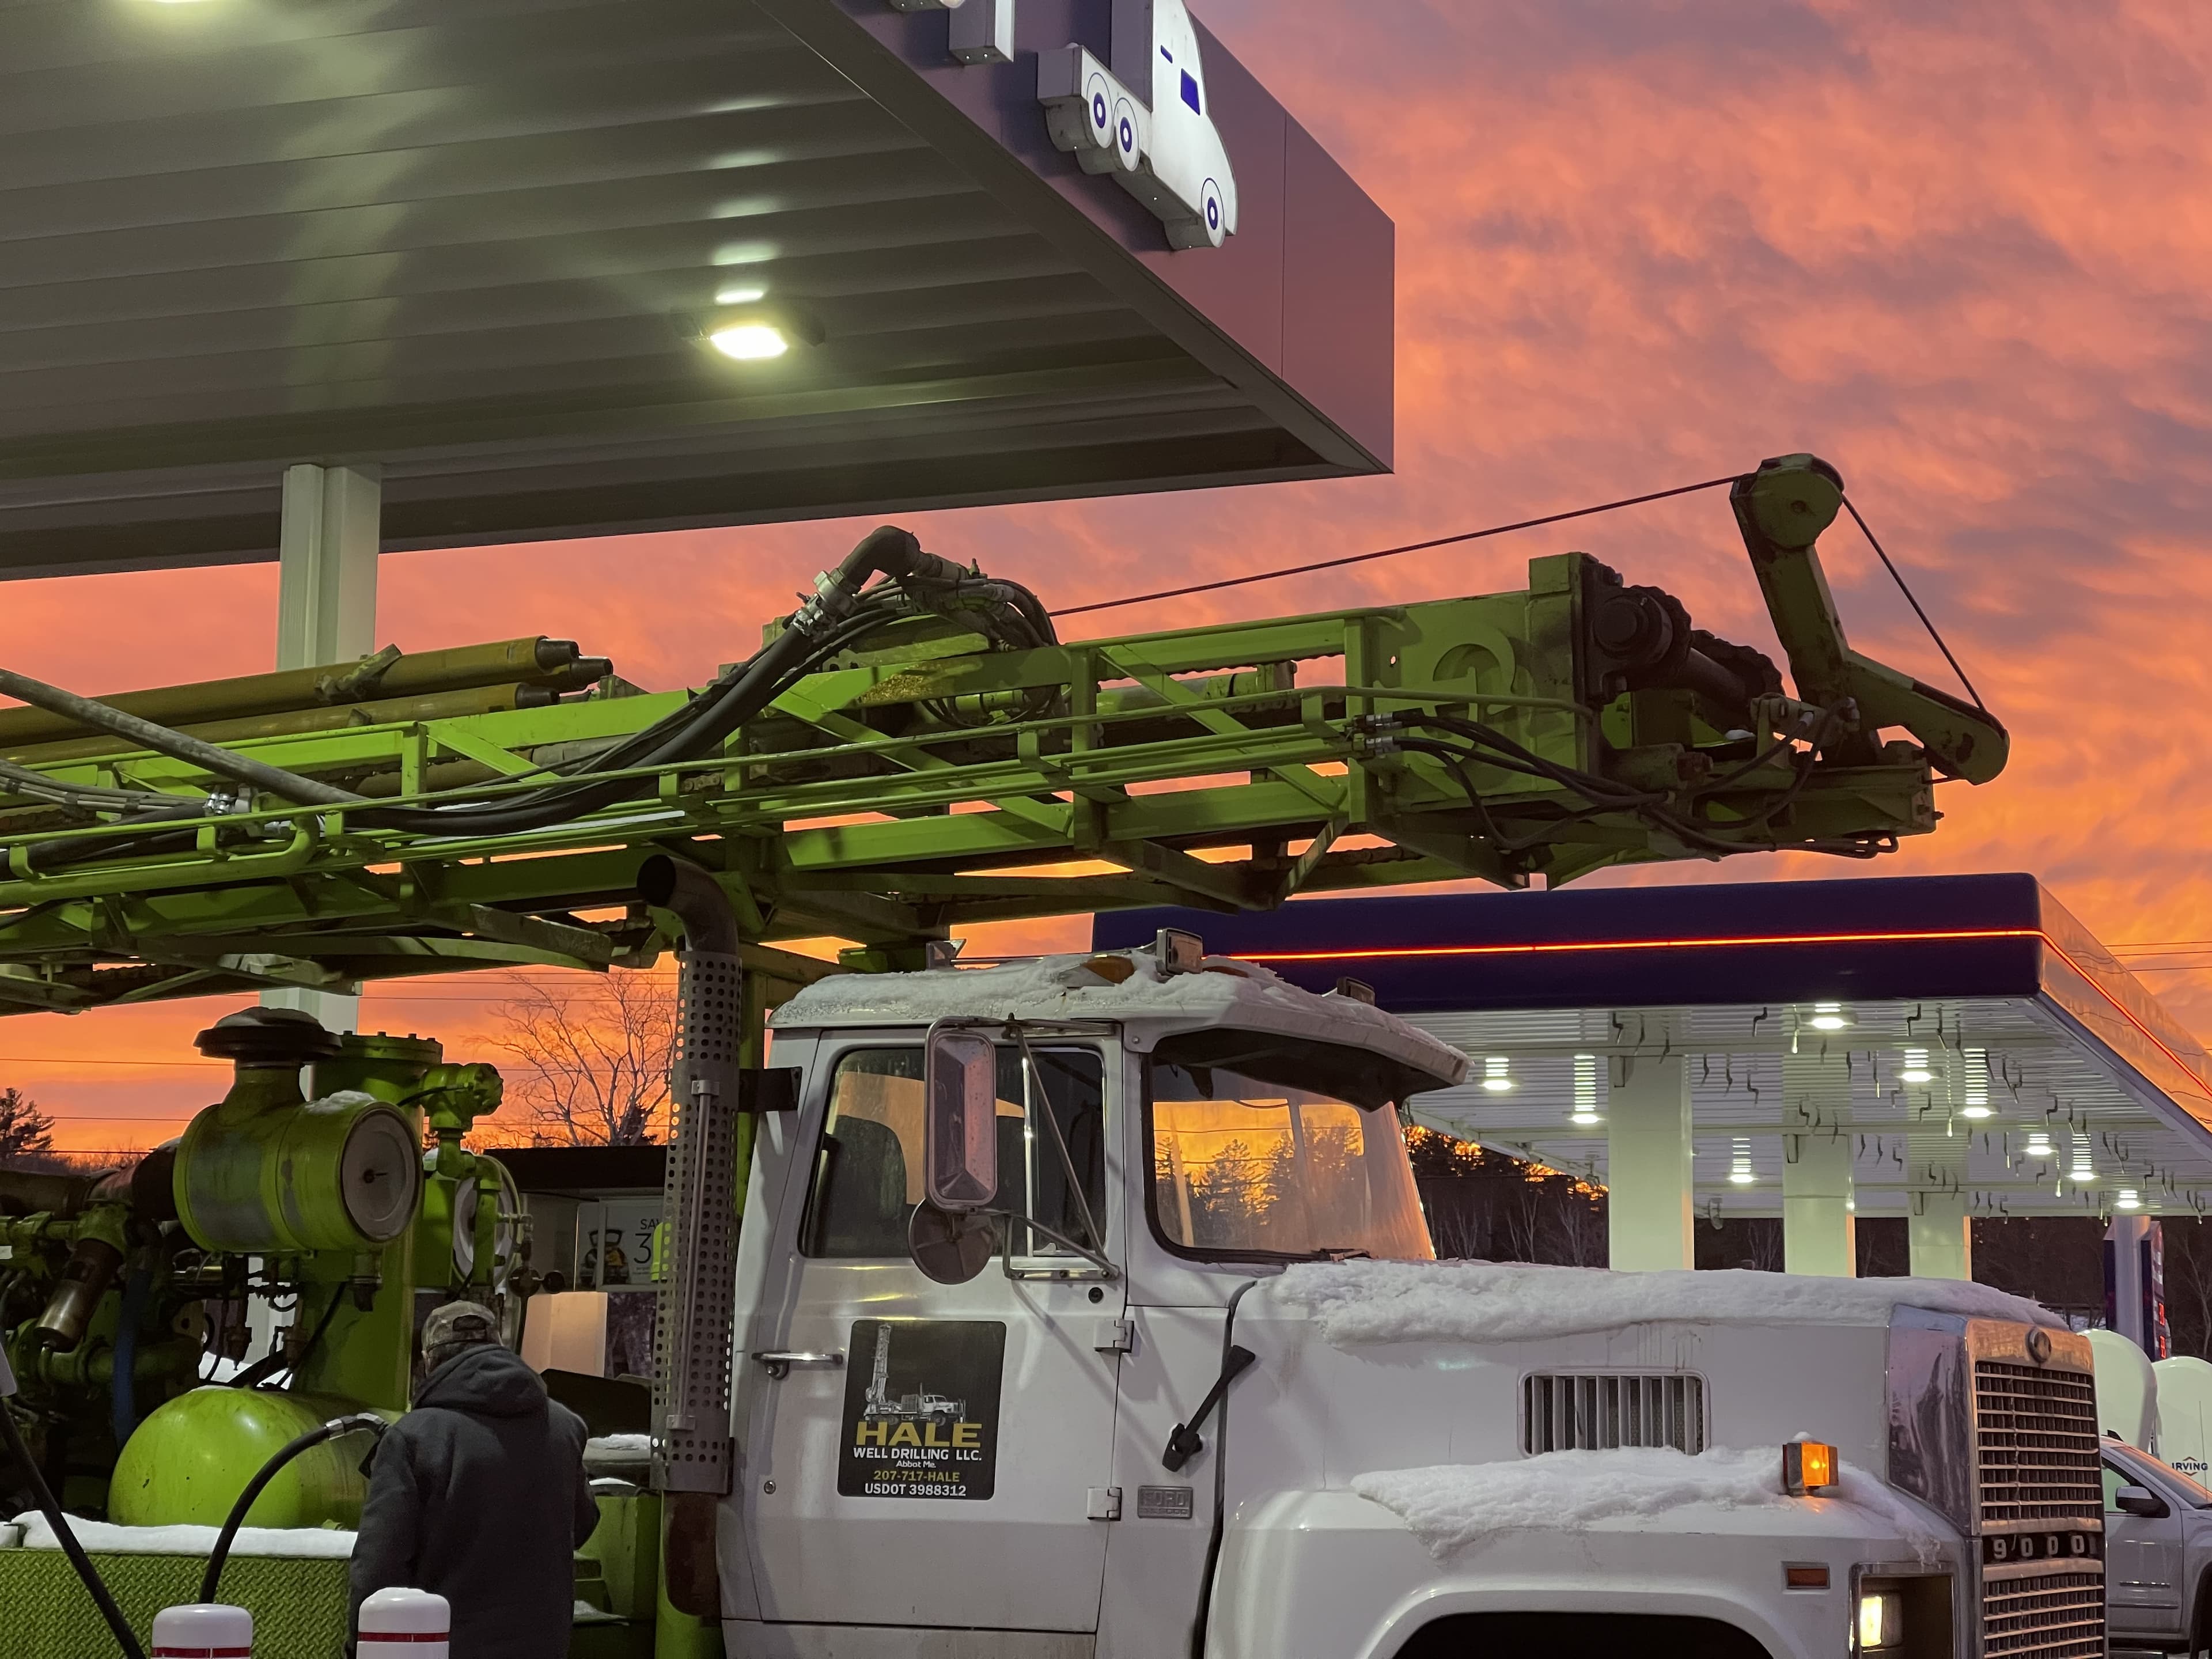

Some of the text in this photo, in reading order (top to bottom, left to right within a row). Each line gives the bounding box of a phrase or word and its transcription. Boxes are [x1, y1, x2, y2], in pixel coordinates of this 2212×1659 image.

[855, 1421, 982, 1448] HALE
[853, 1447, 982, 1461] WELL DRILLING LLC.
[2172, 1462, 2208, 1471] IRVING
[873, 1470, 960, 1482] 207-717-HALE
[865, 1483, 967, 1497] USDOT 3988312
[1993, 1535, 2085, 1559] 9000
